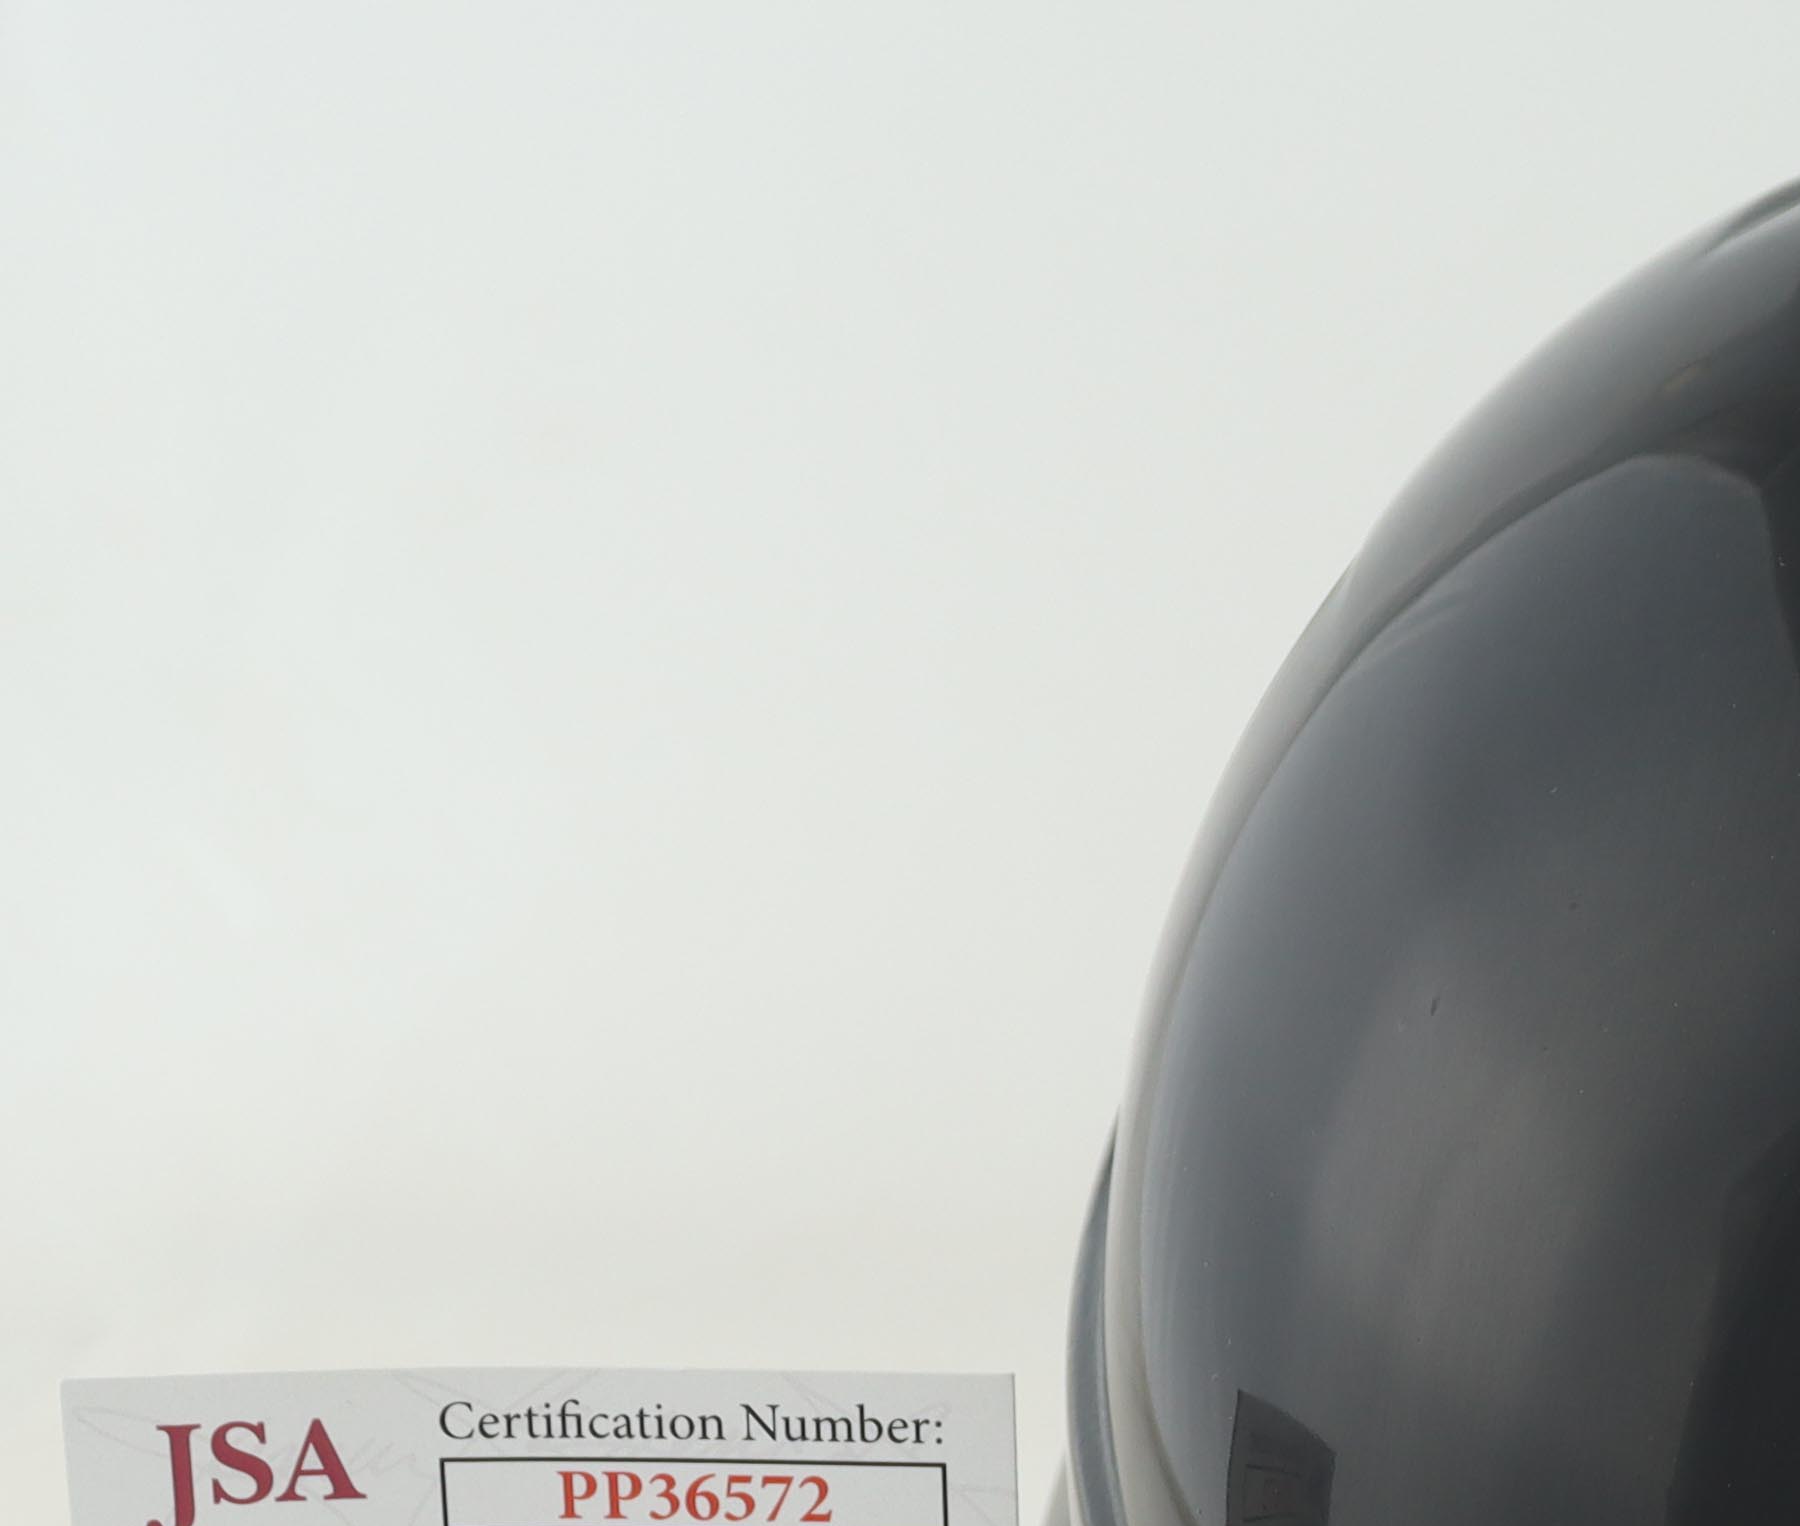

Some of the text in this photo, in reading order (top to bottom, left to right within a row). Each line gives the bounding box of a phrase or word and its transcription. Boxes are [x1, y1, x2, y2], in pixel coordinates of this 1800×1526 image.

[439, 1399, 943, 1444] Certification Number:
[557, 1471, 833, 1523] PP36572
